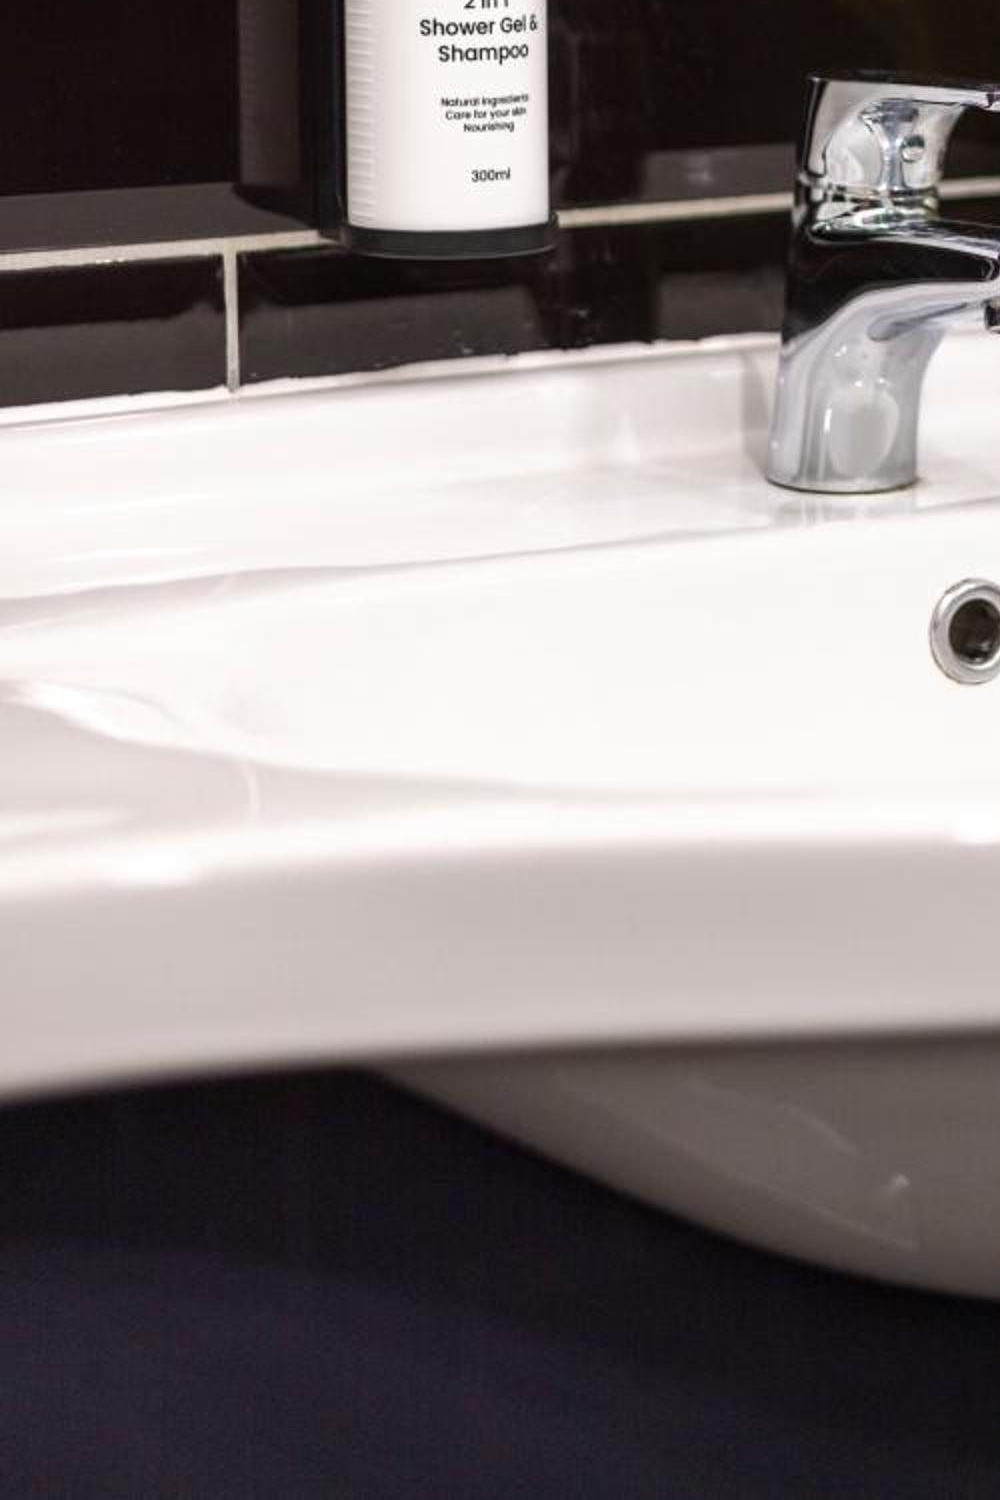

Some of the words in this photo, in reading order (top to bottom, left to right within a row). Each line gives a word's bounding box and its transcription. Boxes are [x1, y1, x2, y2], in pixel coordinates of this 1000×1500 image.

[419, 17, 495, 37] Shower
[500, 14, 527, 34] Gel
[529, 13, 538, 32] &
[438, 43, 529, 66] Shampoo
[445, 110, 472, 120] Care
[473, 109, 487, 119] for
[490, 108, 510, 119] your
[463, 121, 515, 132] Nourishing
[471, 167, 511, 182] 300ml
